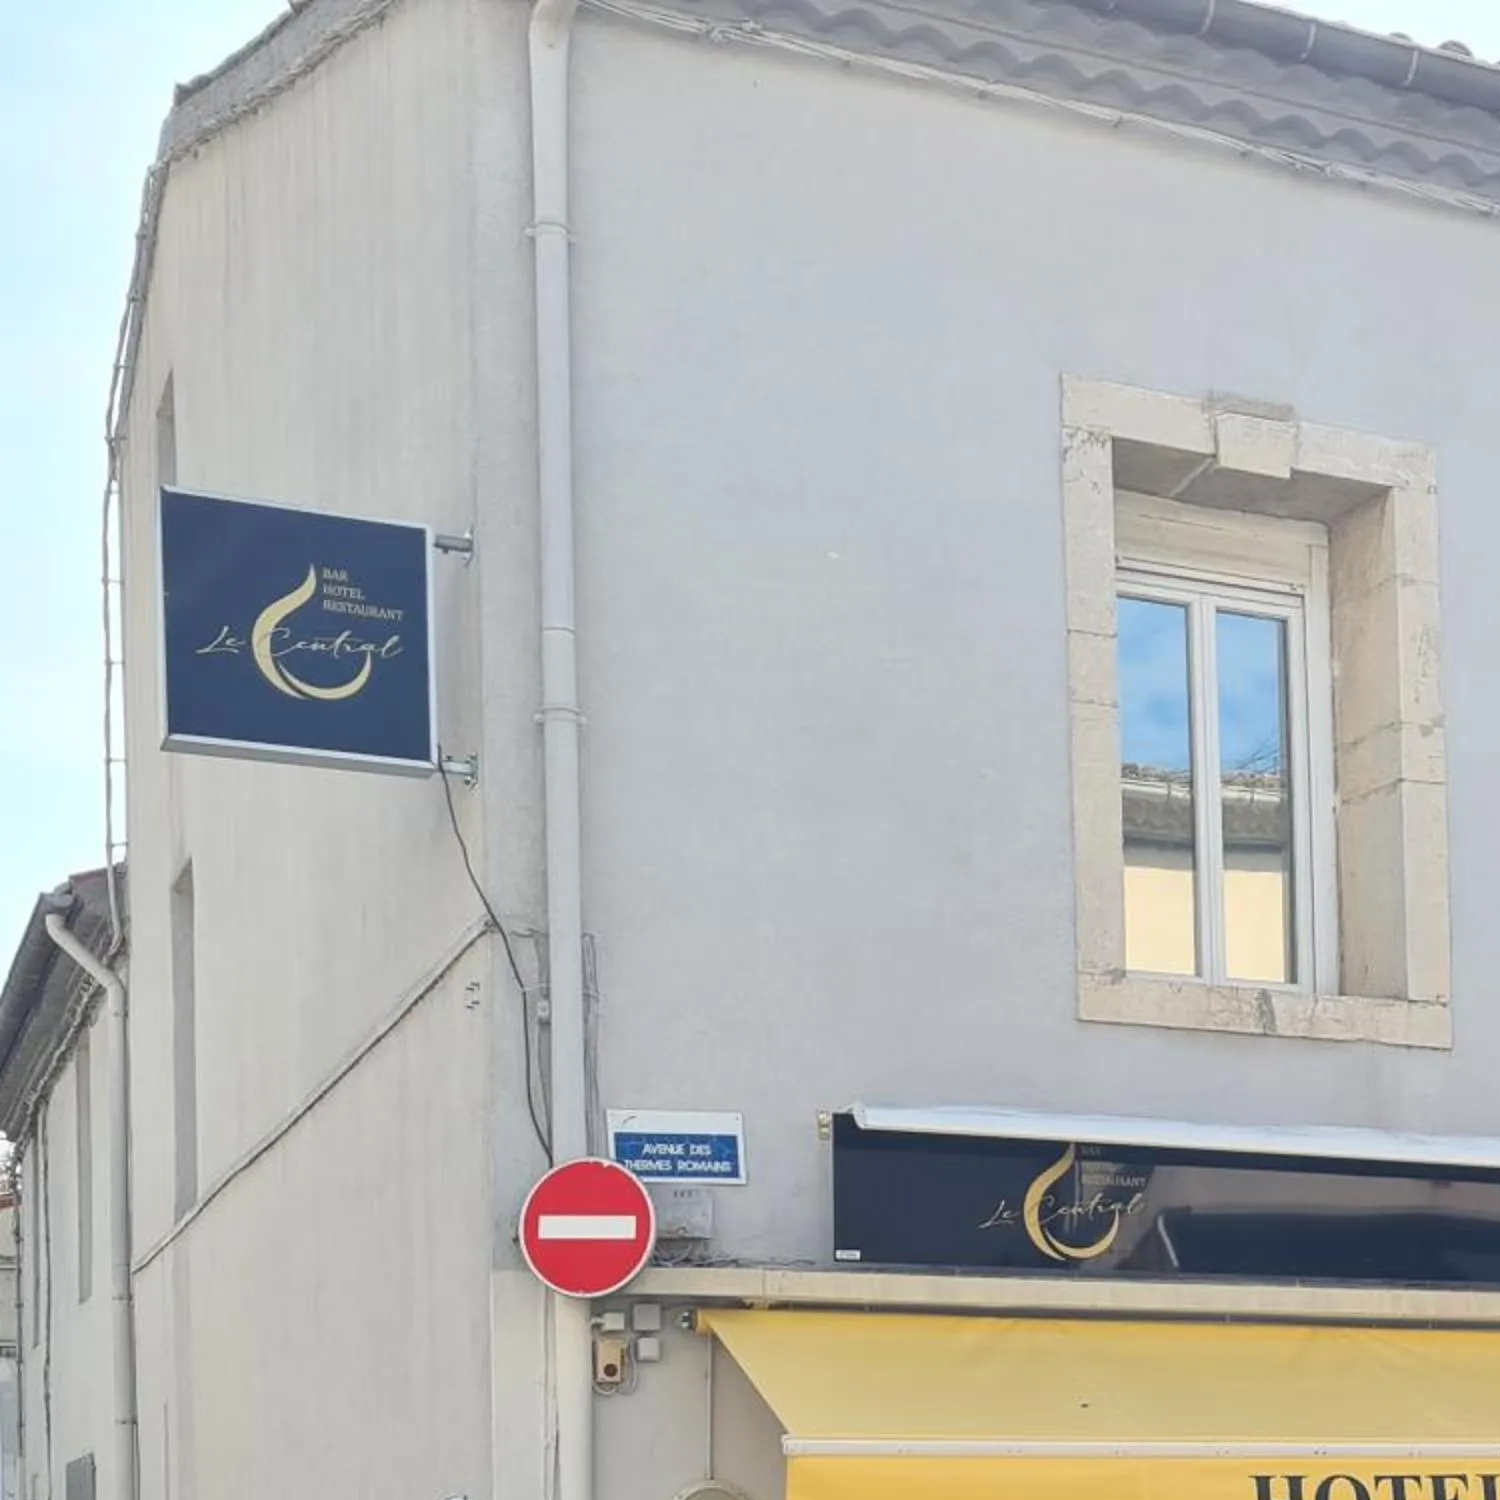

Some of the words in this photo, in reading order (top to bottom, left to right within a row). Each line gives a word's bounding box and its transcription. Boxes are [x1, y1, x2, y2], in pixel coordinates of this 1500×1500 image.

[323, 567, 348, 581] BAR
[323, 583, 366, 600] HOTEL
[323, 600, 404, 621] RESTAURANT
[196, 625, 246, 654] Le
[256, 627, 405, 660] Central
[641, 1143, 685, 1156] AVENUE
[688, 1144, 712, 1156] DES
[677, 1161, 733, 1173] ROMAINS
[977, 1200, 1020, 1229] Le
